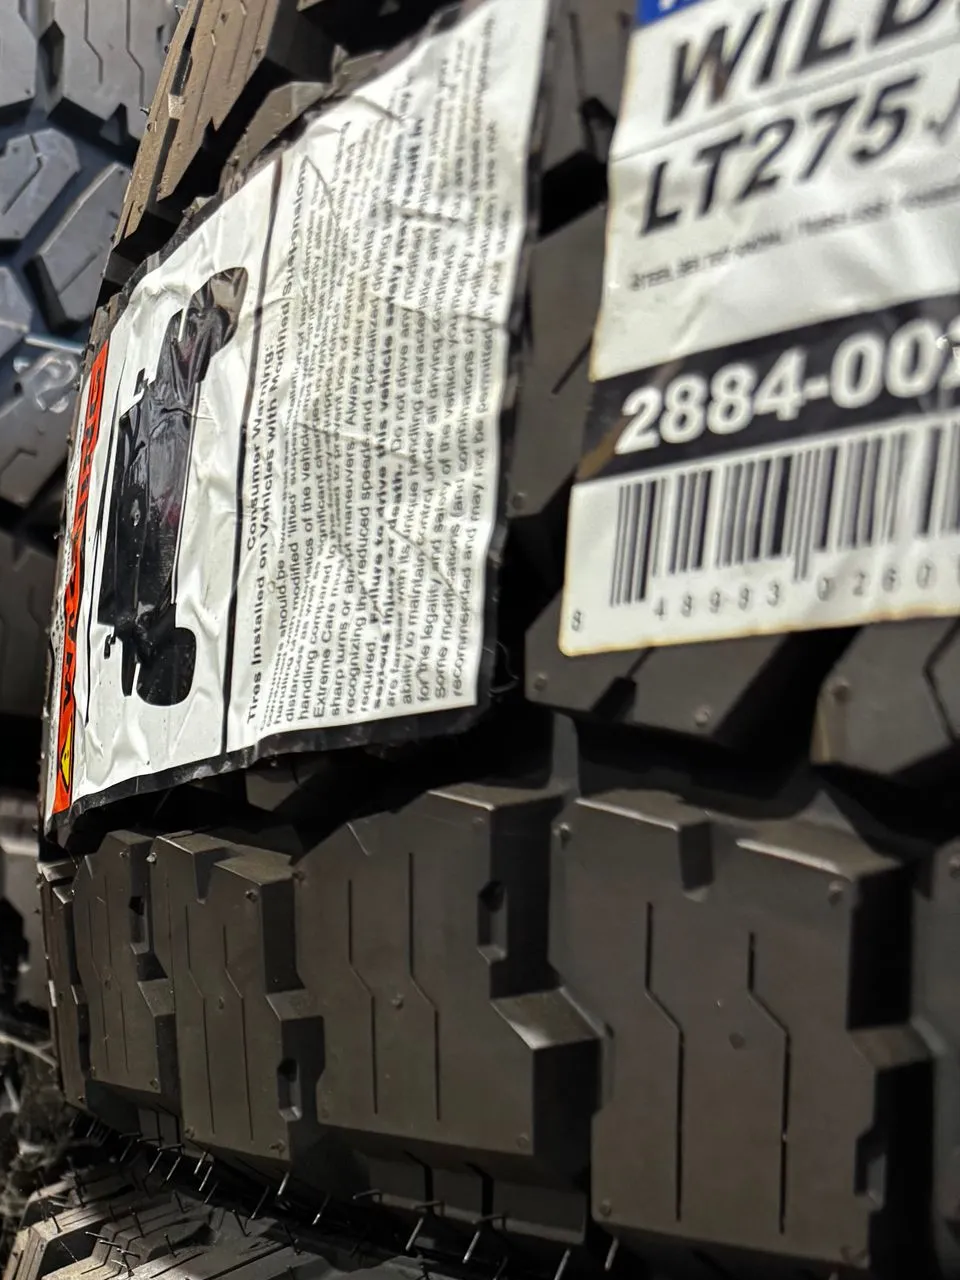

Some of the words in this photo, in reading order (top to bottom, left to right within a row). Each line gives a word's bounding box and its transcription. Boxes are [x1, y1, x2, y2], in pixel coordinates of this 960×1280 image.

[383, 264, 403, 327] safely
[400, 304, 414, 338] any
[268, 301, 291, 392] Modified
[351, 319, 363, 361] wear
[364, 297, 379, 394] specialized
[447, 314, 459, 346] you
[252, 342, 274, 438] Warning:
[377, 334, 393, 412] vehicle
[395, 343, 409, 388] drive
[426, 338, 445, 399] driving
[442, 353, 456, 417] vehicle
[474, 326, 493, 413] permitted
[265, 397, 278, 442] with
[344, 365, 361, 425] Always
[362, 399, 372, 433] and
[392, 392, 406, 421] not
[425, 405, 437, 424] all
[455, 350, 474, 472] combinations
[374, 419, 387, 458] this
[389, 425, 403, 452] Do
[424, 430, 435, 481] under
[437, 424, 451, 452] the
[471, 419, 485, 443] be
[438, 458, 451, 476] of
[472, 449, 485, 476] not
[245, 444, 261, 551] Consumer
[259, 447, 275, 538] Vehicles
[300, 485, 311, 512] the
[374, 465, 386, 519] drive
[385, 464, 404, 529] death.
[414, 488, 434, 546] control
[450, 479, 465, 518] (and
[468, 483, 484, 522] may
[301, 516, 312, 533] of
[355, 506, 369, 575] reduced
[372, 525, 384, 546] to
[386, 537, 395, 558] or
[462, 527, 477, 560] and
[258, 542, 268, 569] on
[275, 559, 285, 579] be
[289, 541, 299, 611] modified
[385, 678, 398, 707] are
[397, 544, 410, 564] its
[406, 399, 424, 476] handling
[427, 538, 442, 572] and
[276, 583, 287, 637] should
[284, 643, 305, 723] distances
[300, 620, 309, 640] as
[315, 473, 325, 558] significant
[340, 599, 351, 617] or
[380, 565, 396, 625] injury
[407, 548, 426, 625] maintain
[419, 577, 442, 640] legality
[250, 576, 265, 665] Installed
[296, 649, 318, 721] handling
[308, 564, 333, 645] compared
[320, 602, 336, 643] Care
[334, 621, 349, 664] turns
[403, 631, 415, 647] to
[451, 566, 472, 697] recommended
[312, 647, 331, 719] Extreme
[343, 614, 366, 715] recognizing
[358, 635, 377, 712] required.
[372, 631, 391, 709] serious
[399, 652, 416, 704] ability
[416, 644, 431, 672] the
[246, 671, 262, 723] Tires
[273, 656, 294, 724] handling
[328, 668, 345, 717] sharp
[416, 680, 430, 702] for
